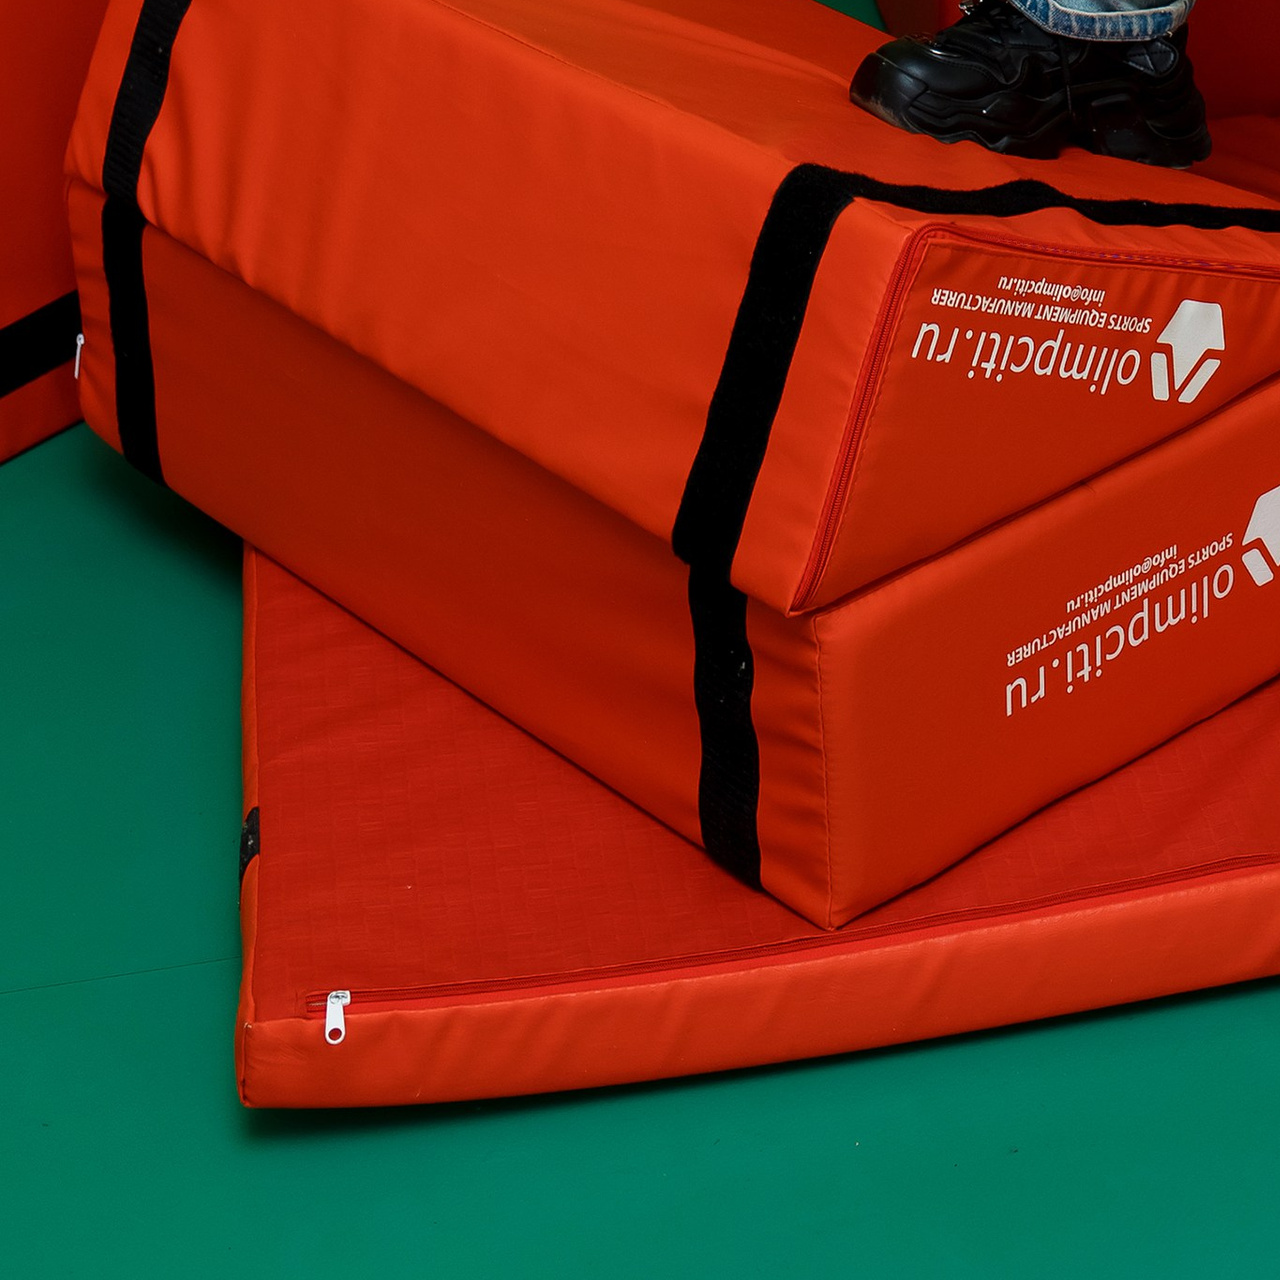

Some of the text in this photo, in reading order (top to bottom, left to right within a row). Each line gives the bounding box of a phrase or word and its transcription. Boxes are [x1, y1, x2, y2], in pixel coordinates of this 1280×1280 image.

[932, 289, 1153, 333] SPORTS EQUIPMENT MANUFACTURER
[998, 277, 1105, 306] info@olimpciti.ru
[911, 323, 1141, 395] olimpciti.ru
[1007, 533, 1233, 667] SPORTS EQUIPMENT MANUFACTURER
[1067, 544, 1177, 613] info@olimpciti.ru
[1006, 565, 1234, 717] olimpciti.ru
